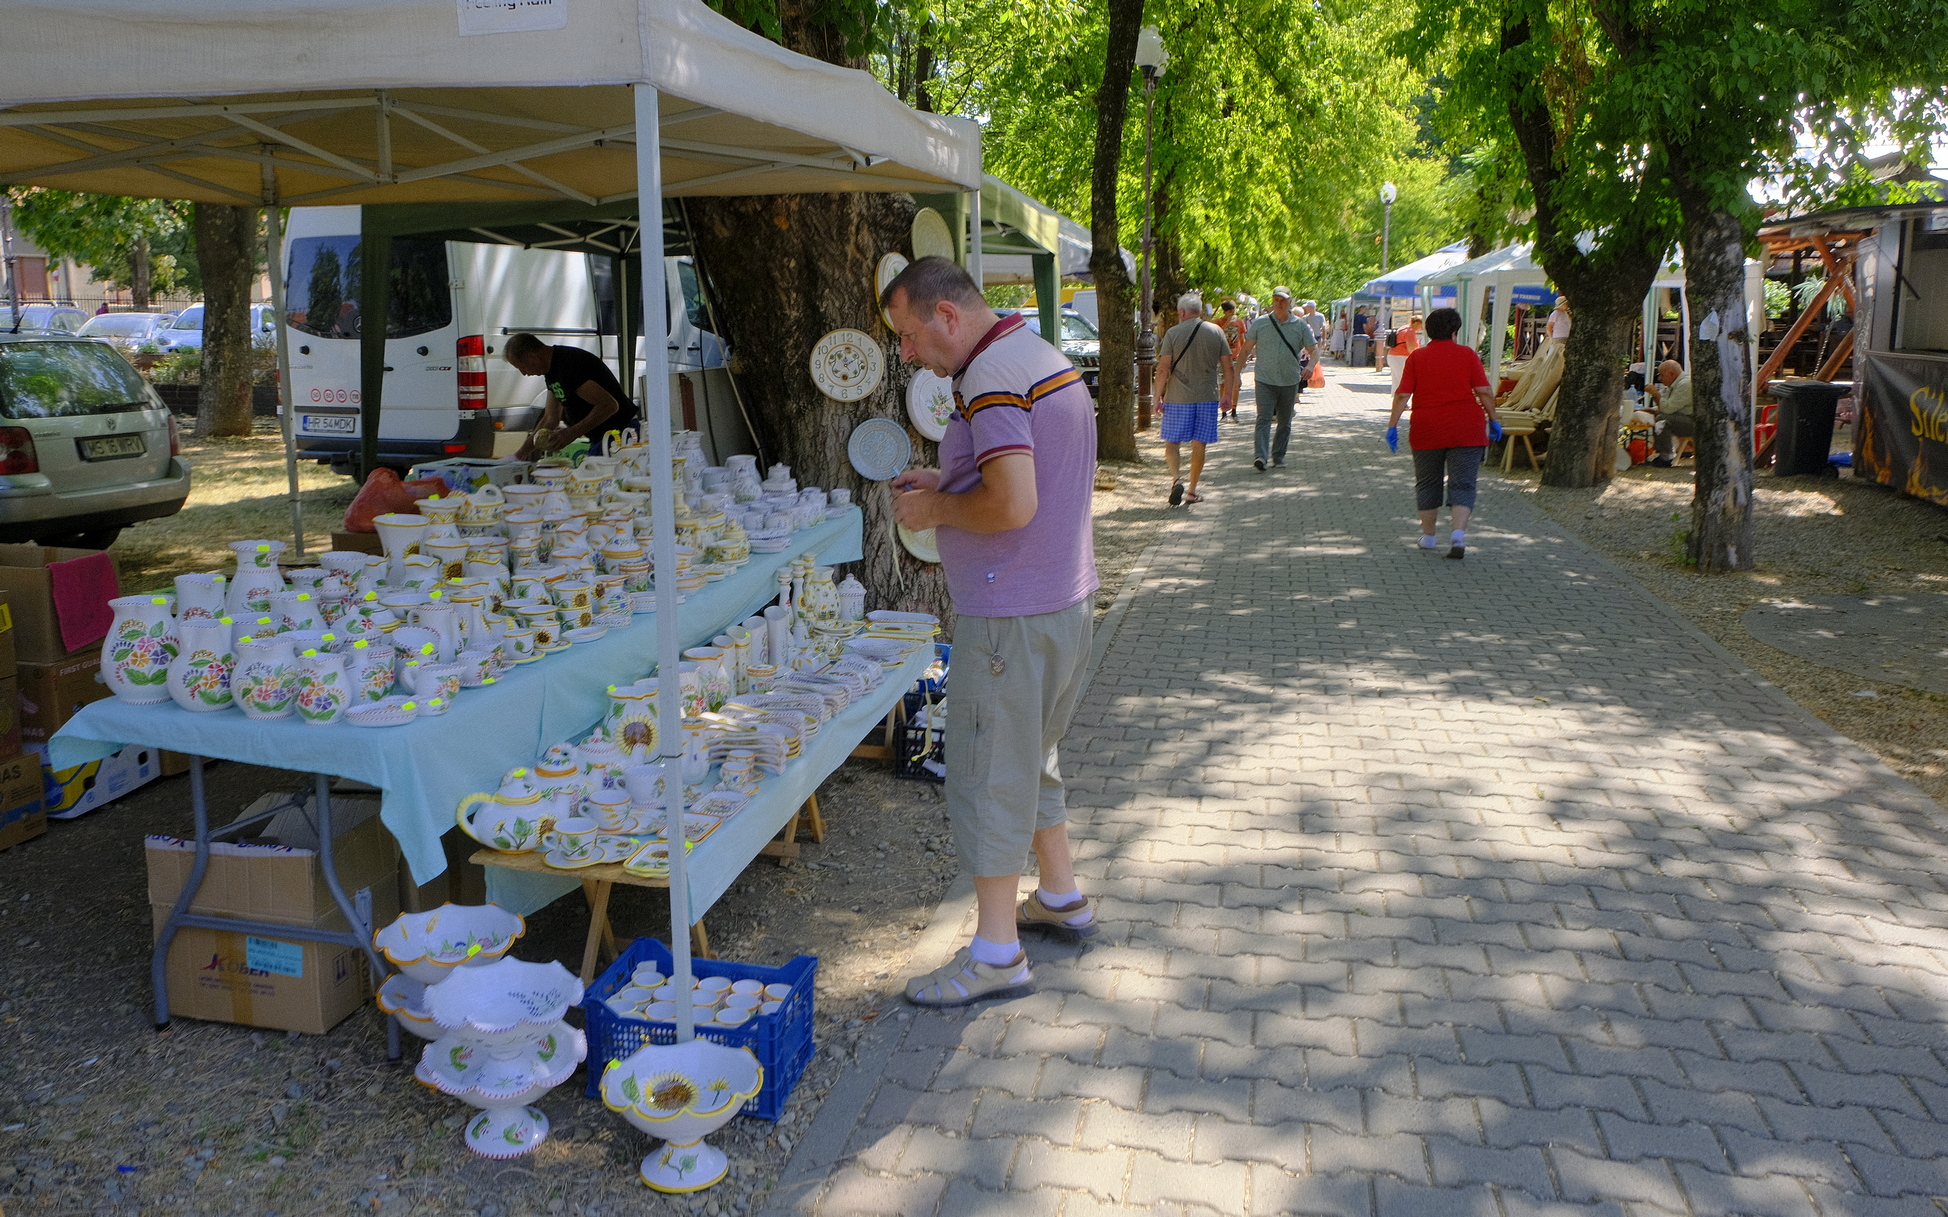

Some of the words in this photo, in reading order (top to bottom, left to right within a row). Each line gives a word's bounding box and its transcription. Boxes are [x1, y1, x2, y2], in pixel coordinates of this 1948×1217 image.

[829, 335, 837, 346] 11
[841, 332, 853, 343] 12
[858, 336, 863, 347] 1
[817, 345, 829, 356] 10
[867, 347, 874, 358] 2
[814, 359, 822, 370] 9
[870, 361, 877, 372] 3
[818, 373, 825, 383] 8
[865, 376, 872, 386] 4
[828, 385, 834, 395] 7
[841, 388, 848, 399] 6
[856, 385, 863, 395] 5
[308, 417, 320, 428] HR
[60, 663, 80, 676] FIRST
